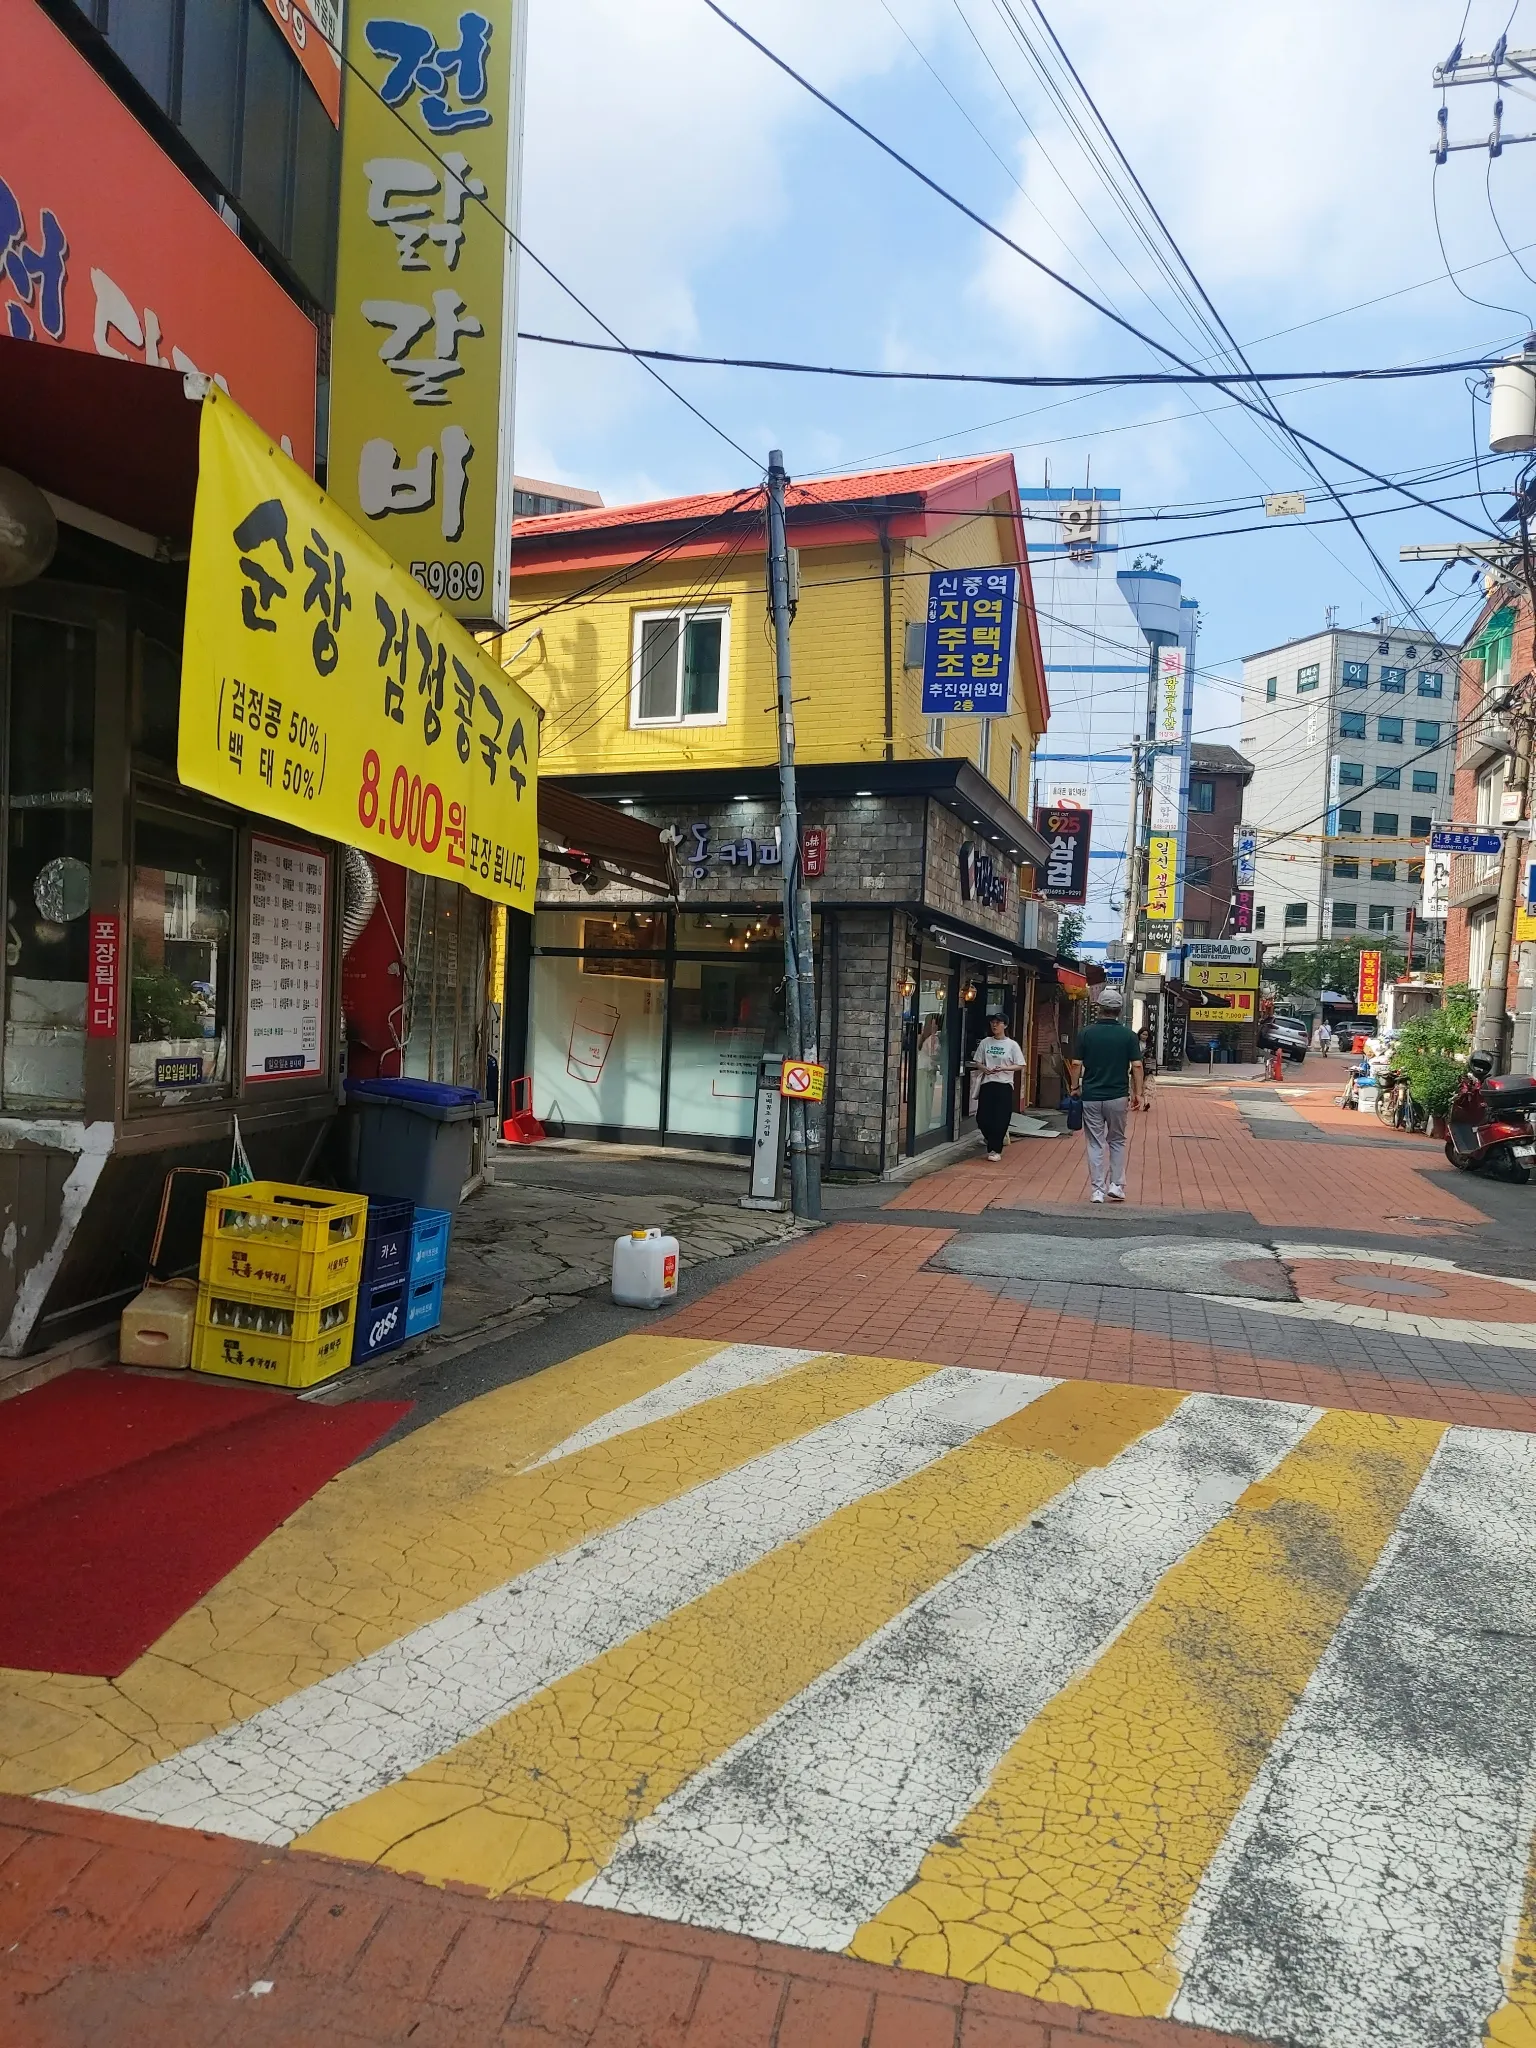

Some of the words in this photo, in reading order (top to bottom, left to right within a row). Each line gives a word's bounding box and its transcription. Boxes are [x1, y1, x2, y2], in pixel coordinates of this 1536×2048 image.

[939, 599, 1002, 624] 지역
[233, 499, 352, 677] 순창
[375, 591, 528, 802] 검정콩국수
[937, 627, 1002, 651] 주택
[935, 652, 1003, 677] 조합
[929, 682, 1003, 698] 추진위원회
[953, 700, 974, 712] 2층
[1162, 676, 1179, 731] 황금수산
[232, 679, 283, 739] 검정콩
[288, 711, 320, 755] 50%
[228, 729, 244, 776] 백
[259, 746, 275, 789] 태
[282, 757, 315, 801] 50%
[1048, 816, 1081, 833] 925
[1433, 833, 1479, 846] 신풍로6길
[1156, 841, 1169, 870] 일신
[1238, 892, 1250, 927] BAR
[94, 922, 117, 1029] 포장됩니다
[1197, 970, 1247, 985] 생고기
[381, 1242, 398, 1260] 카스
